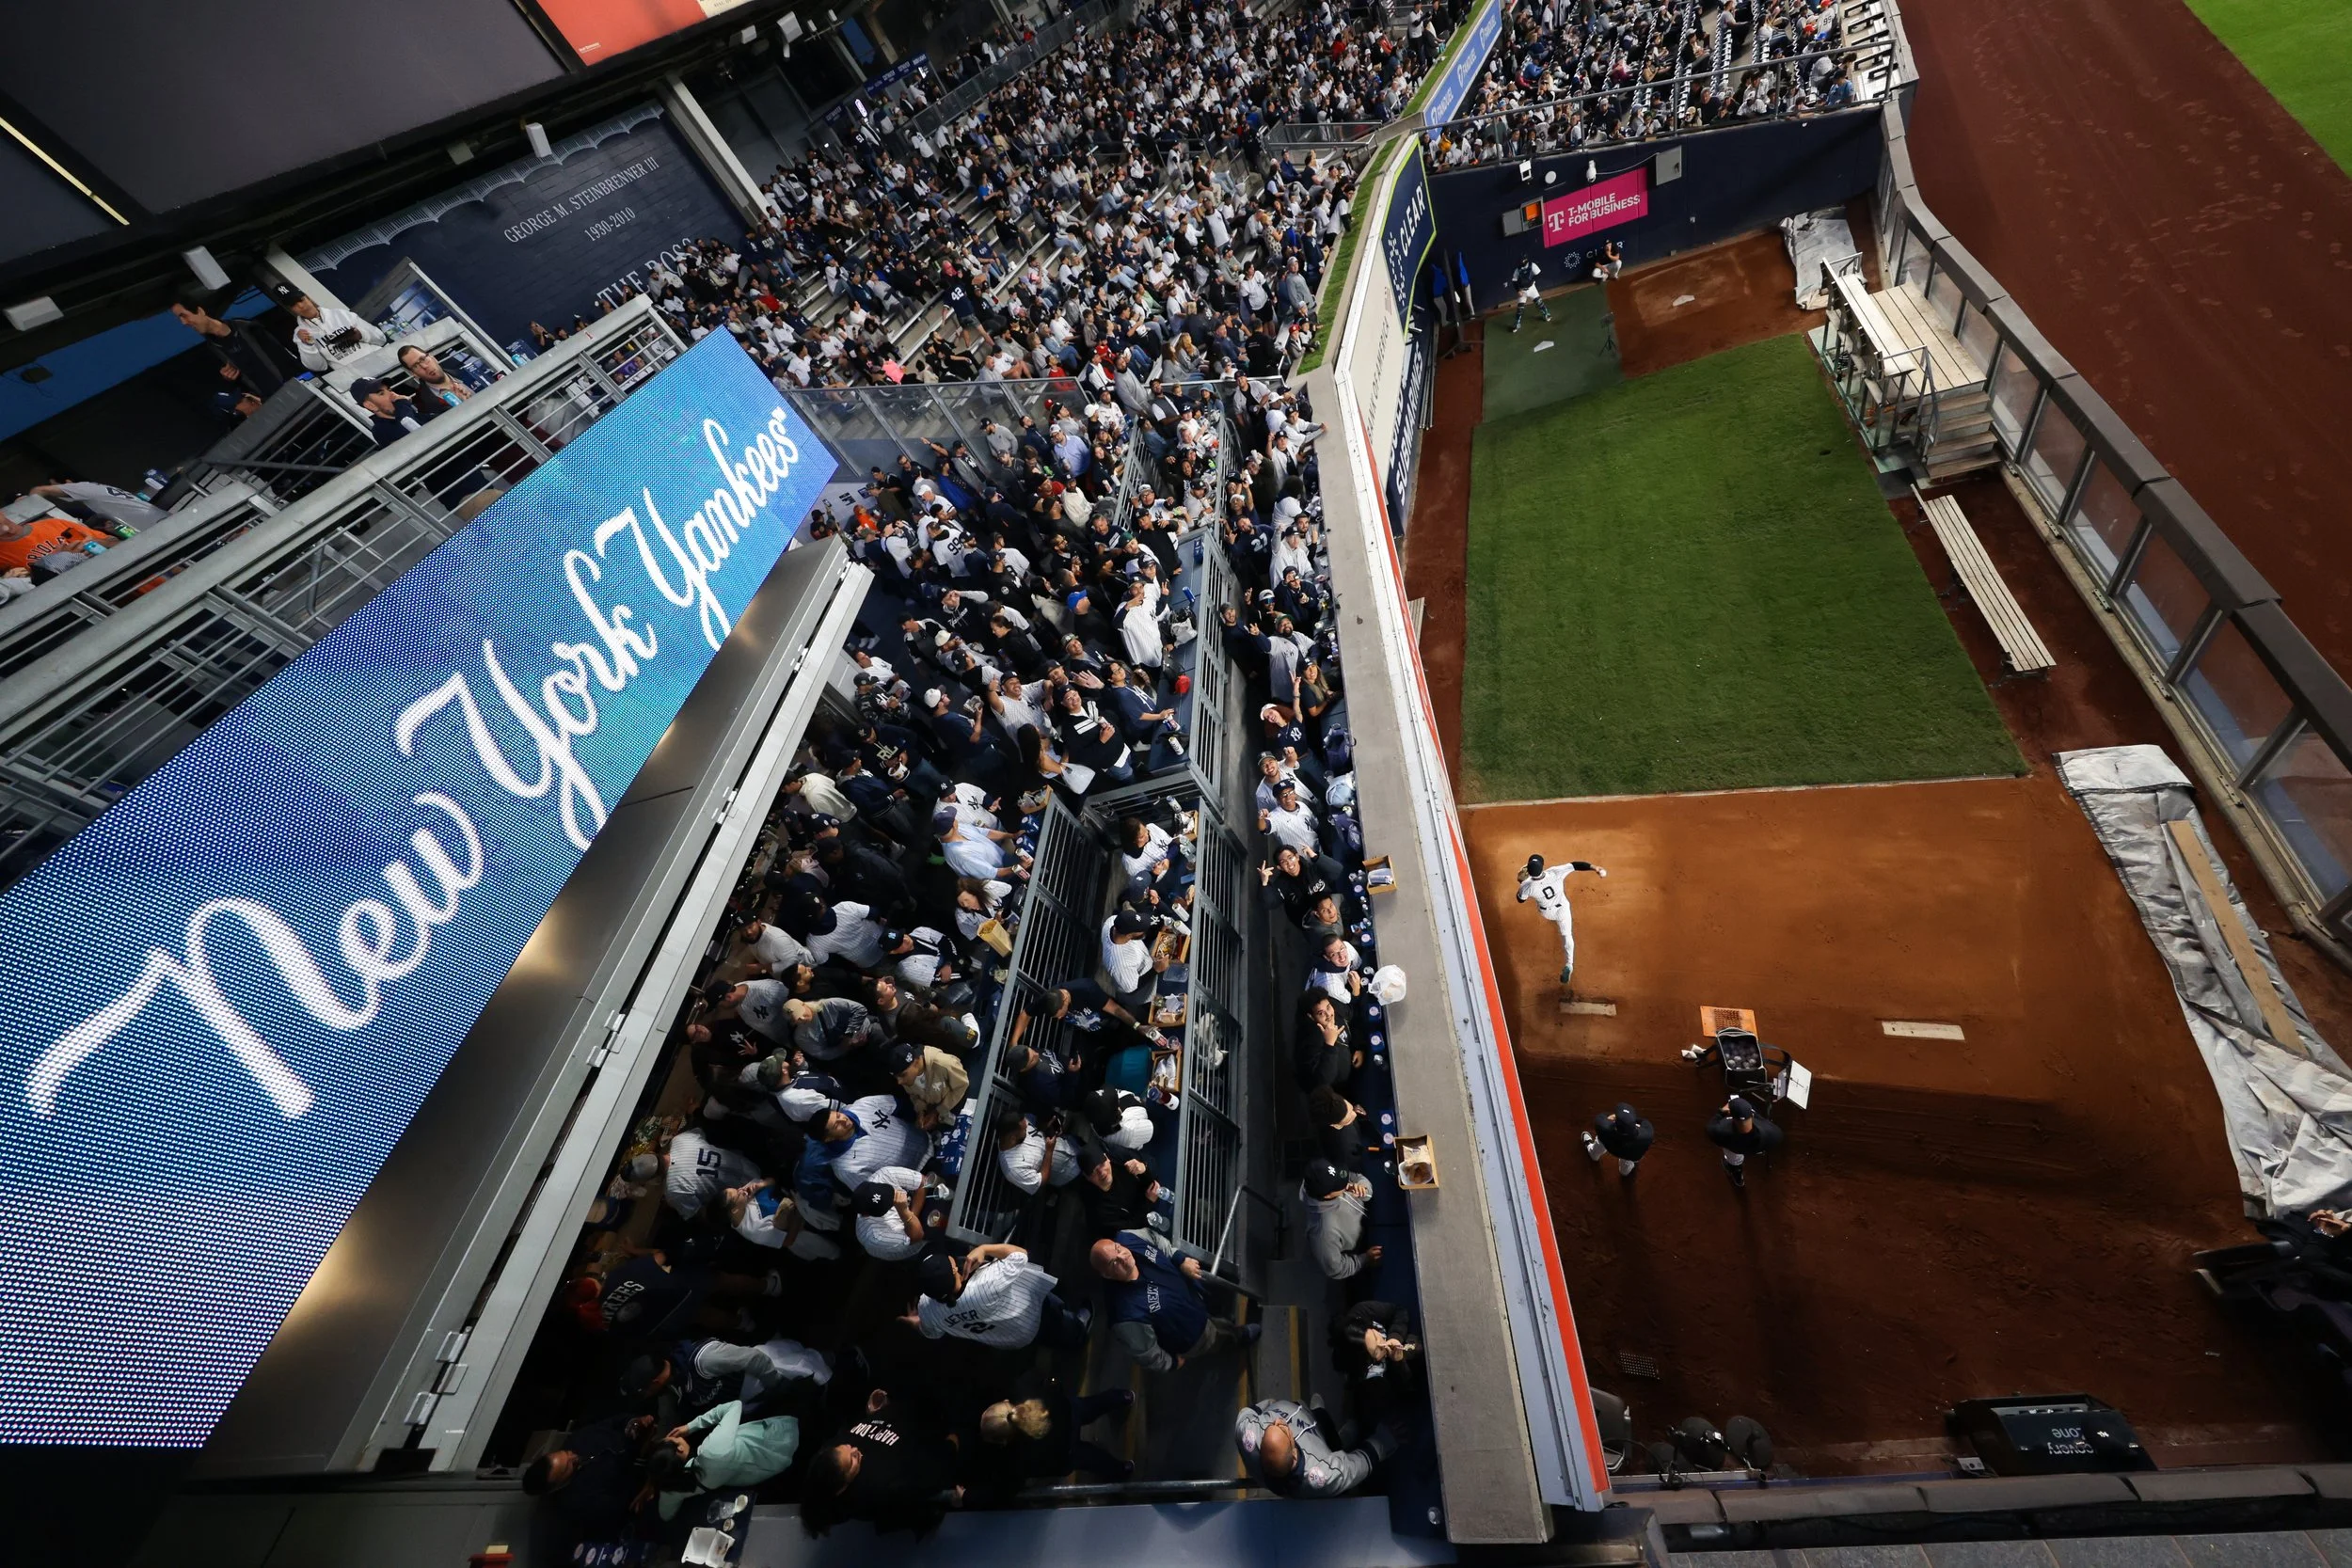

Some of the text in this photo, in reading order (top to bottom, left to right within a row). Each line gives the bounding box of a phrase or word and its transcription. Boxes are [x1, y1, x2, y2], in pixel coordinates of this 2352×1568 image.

[503, 156, 660, 243] GEORGE M. STEINBRENNER III
[1567, 192, 1616, 216] T-MOBILE
[1568, 194, 1641, 228] FOR BUSINESS
[584, 206, 636, 242] 1930-2010
[1399, 185, 1424, 257] CLEAR
[950, 287, 964, 301] 42
[22, 414, 800, 1119] New York Yankees
[1542, 886, 1555, 900] 0
[872, 1109, 891, 1130] NY
[696, 1148, 723, 1180] 15
